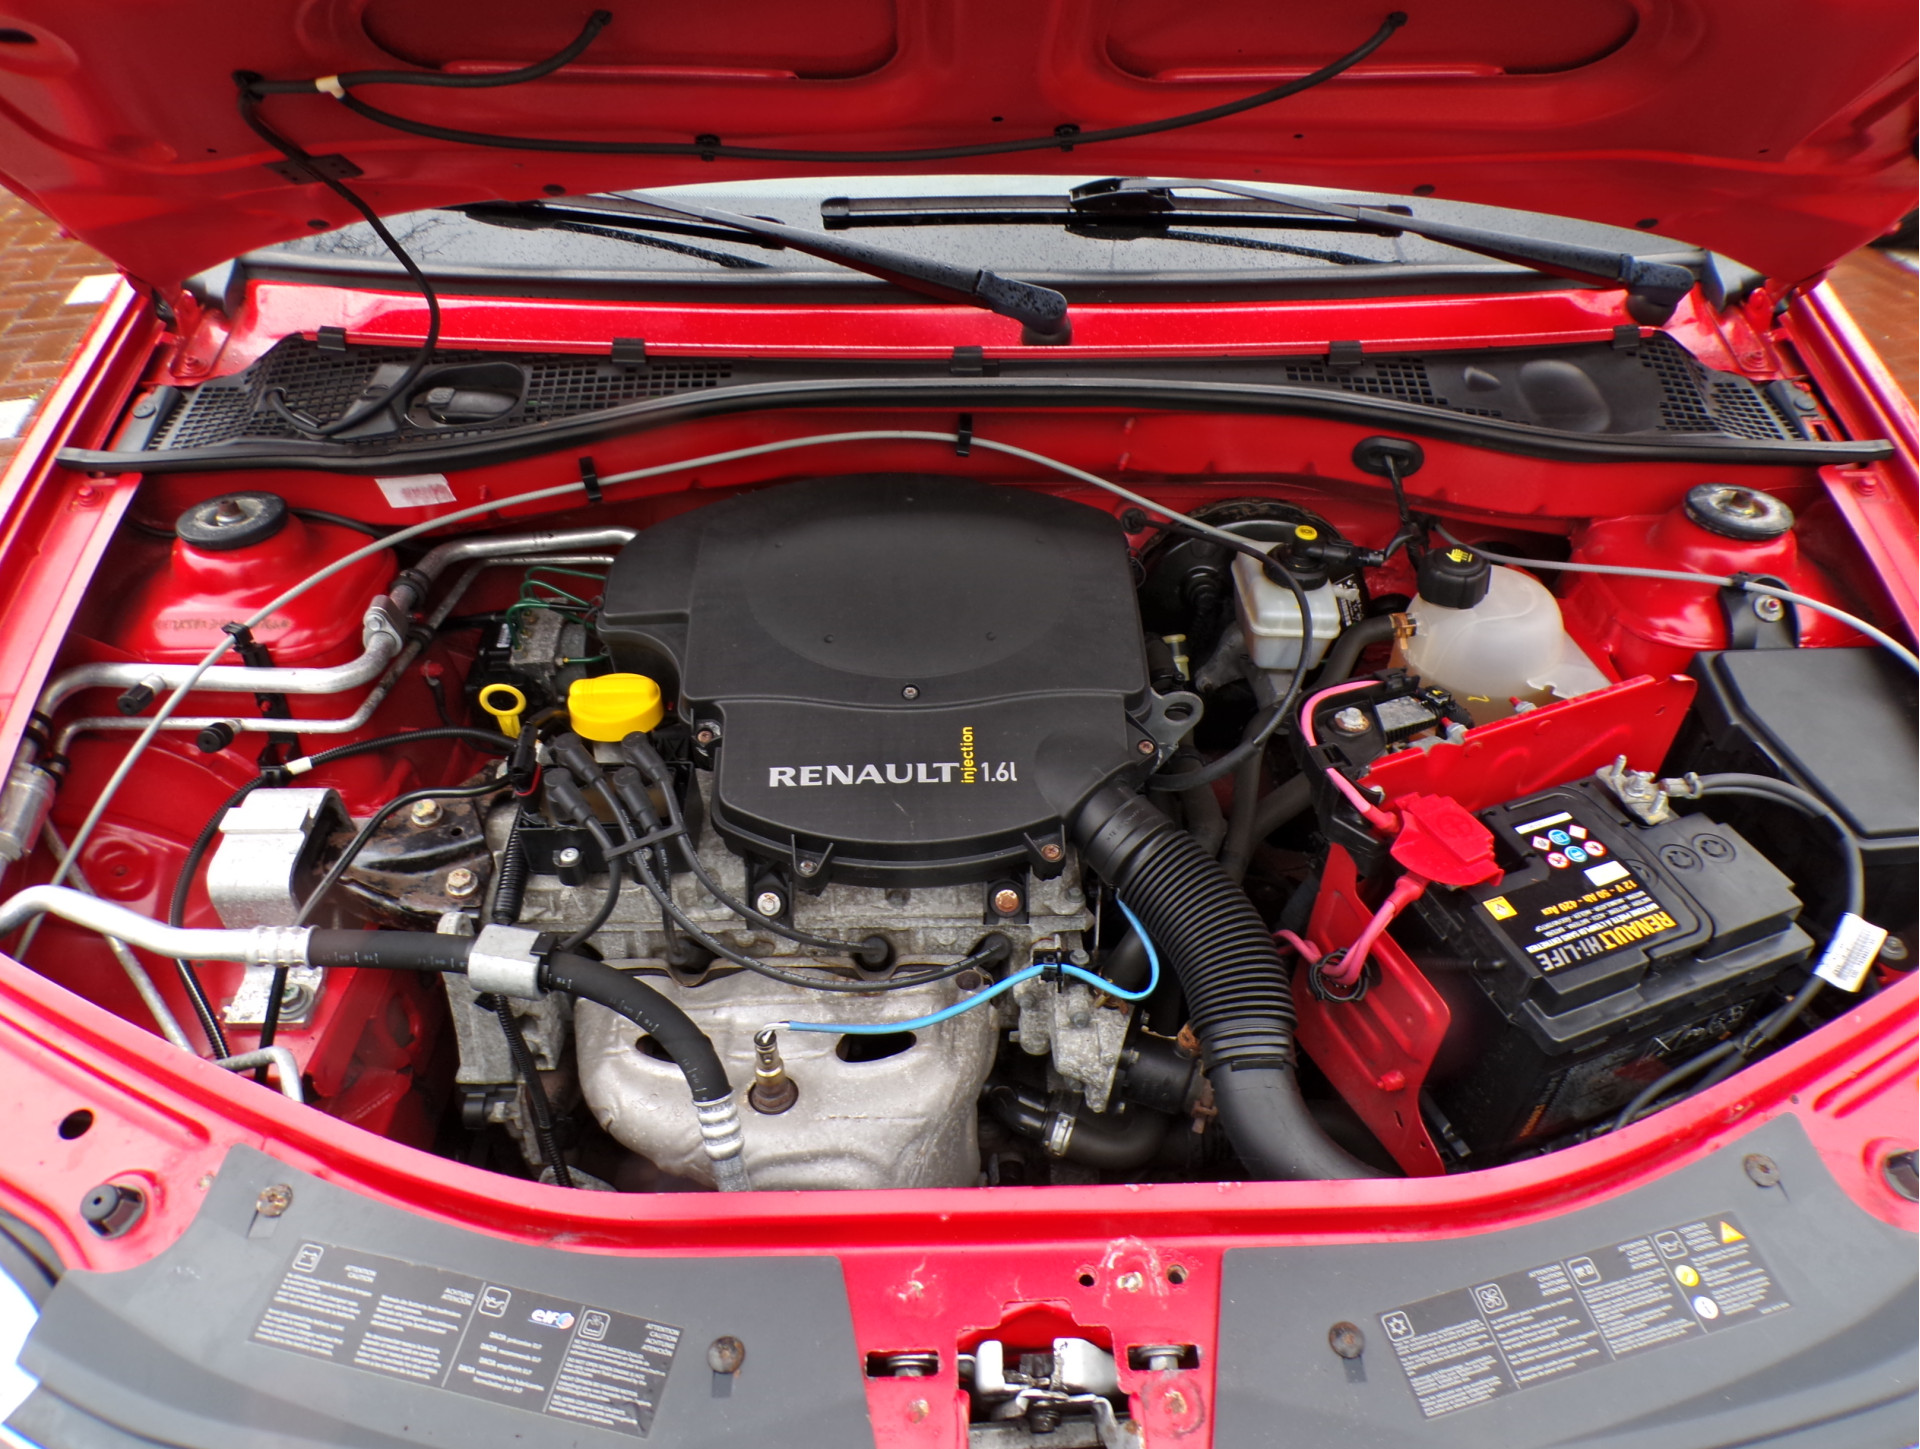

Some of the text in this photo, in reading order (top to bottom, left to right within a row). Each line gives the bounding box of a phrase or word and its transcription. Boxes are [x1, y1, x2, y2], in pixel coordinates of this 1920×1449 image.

[768, 726, 1018, 788] RENAULT injection 1.6l
[1558, 900, 1578, 912] 420
[1598, 910, 1678, 950] RENAULT
[531, 1308, 561, 1324] elf
